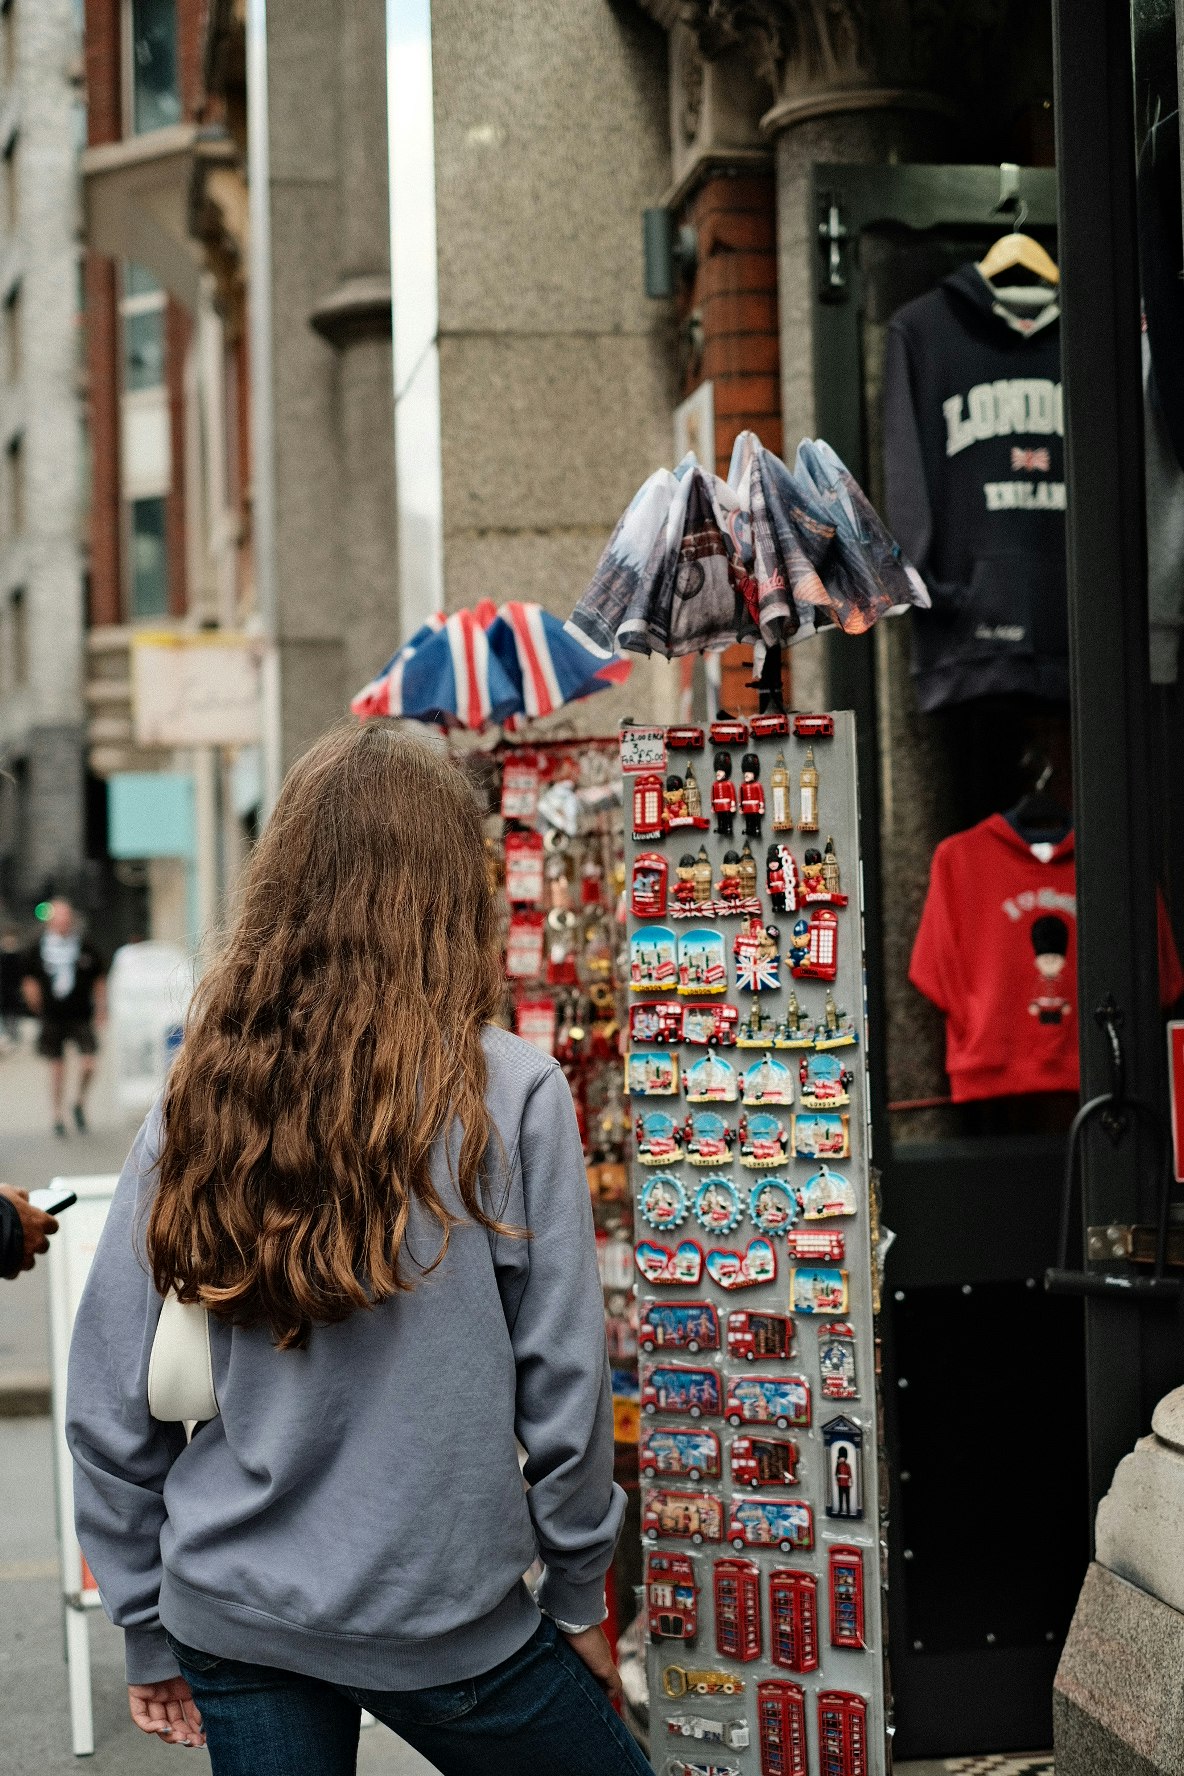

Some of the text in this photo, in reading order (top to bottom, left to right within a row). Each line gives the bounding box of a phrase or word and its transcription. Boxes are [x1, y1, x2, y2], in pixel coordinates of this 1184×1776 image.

[942, 377, 1064, 457] LOND
[984, 481, 1067, 511] ENGLAN
[777, 844, 797, 912] LONDON
